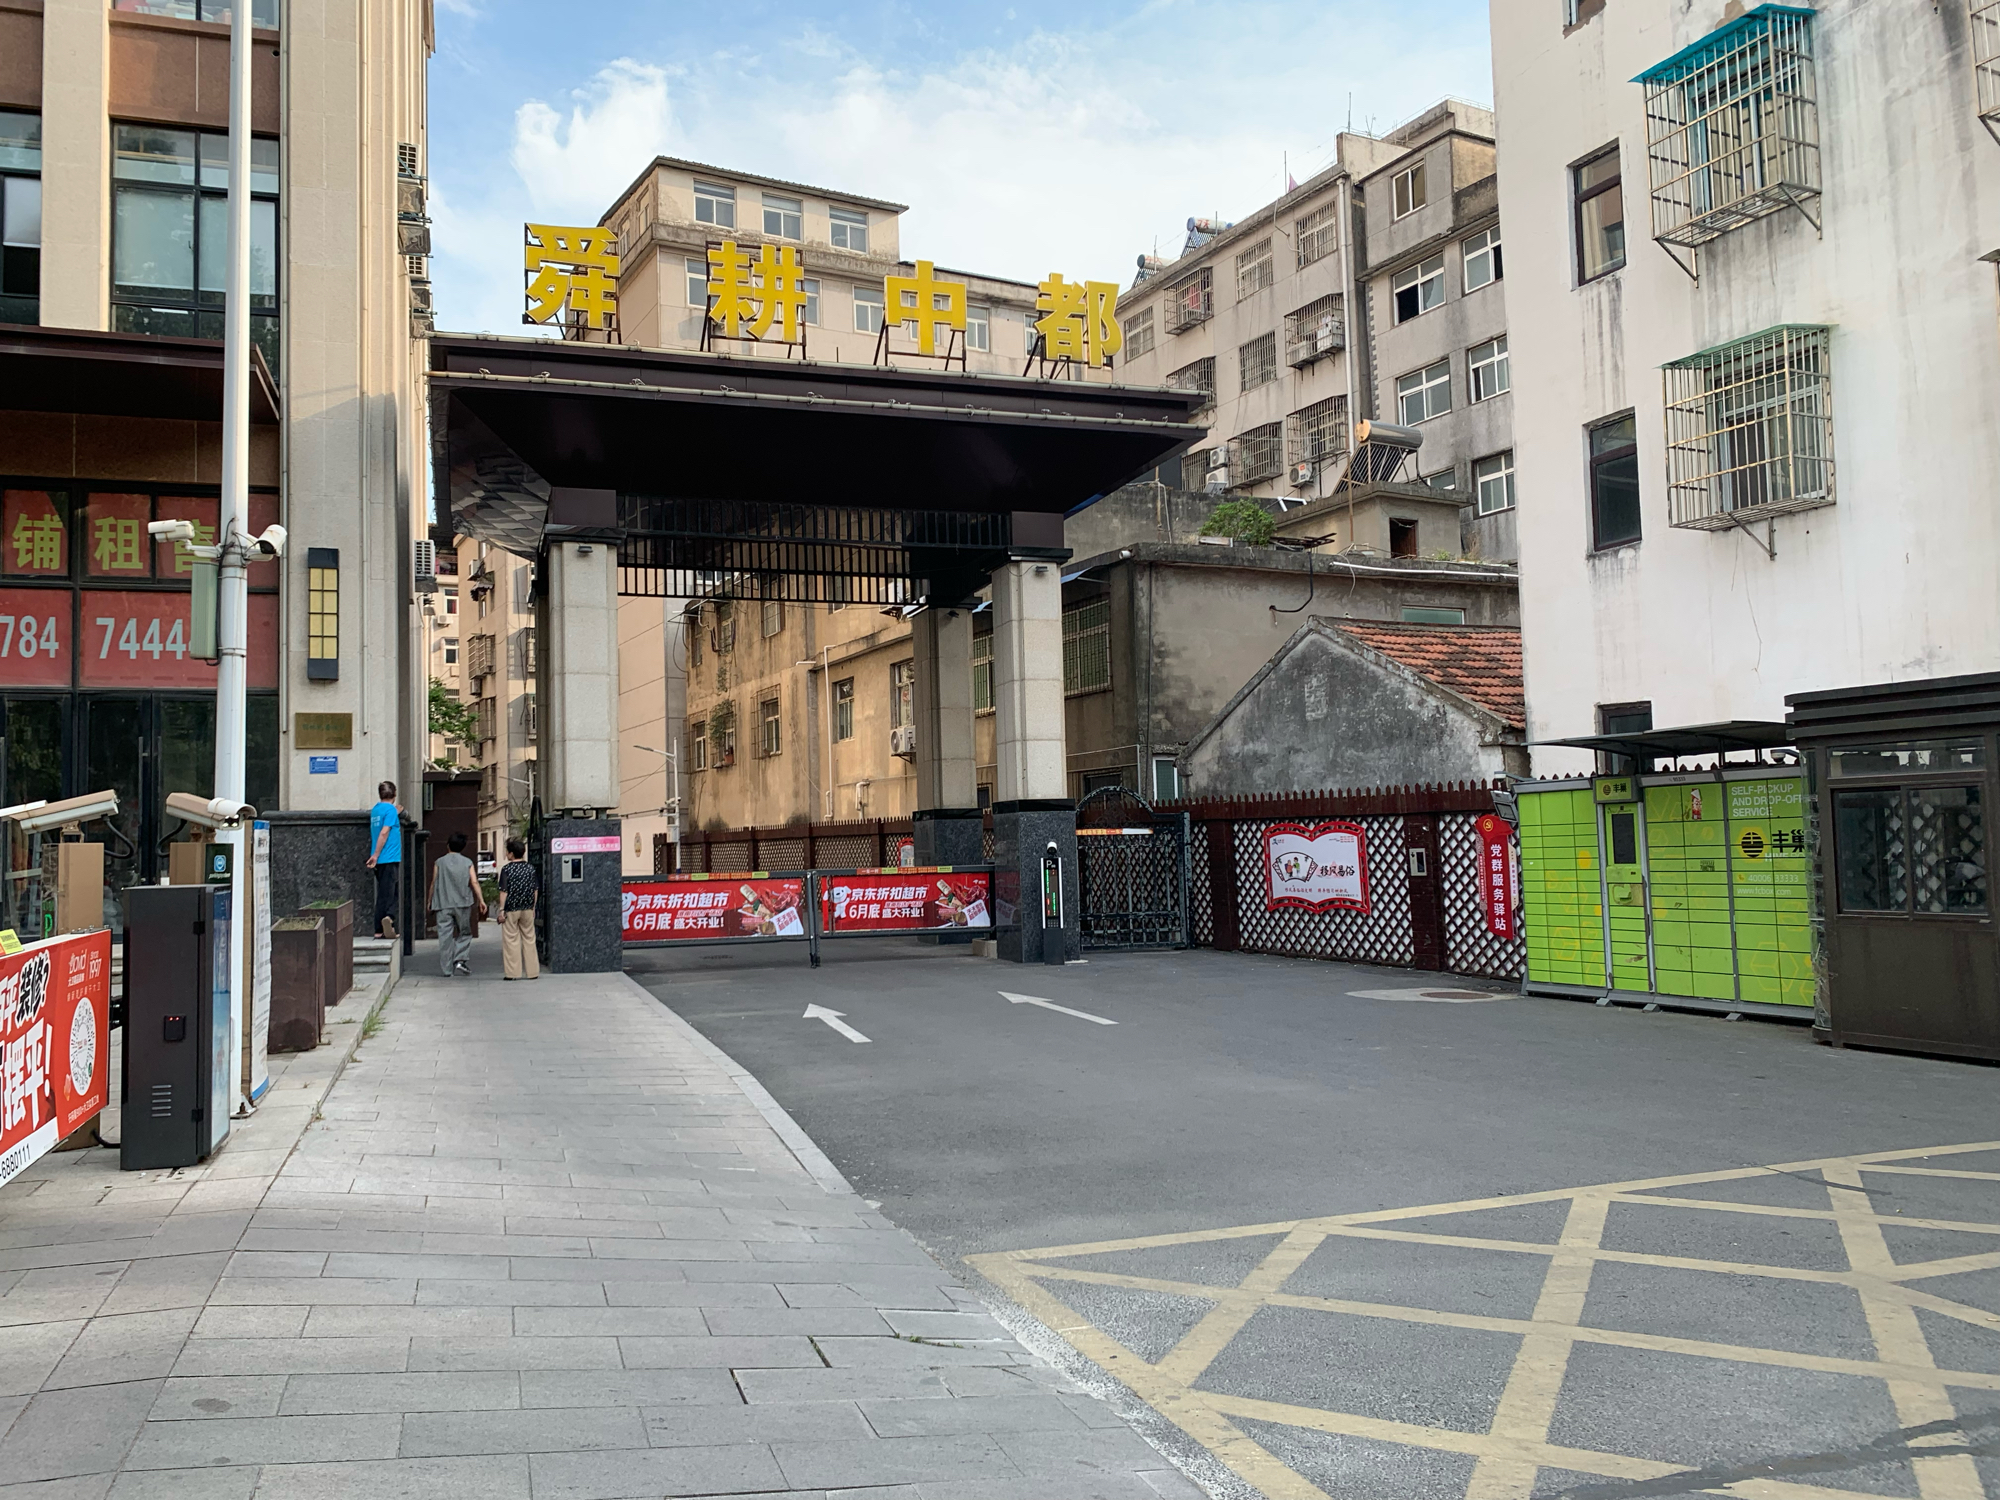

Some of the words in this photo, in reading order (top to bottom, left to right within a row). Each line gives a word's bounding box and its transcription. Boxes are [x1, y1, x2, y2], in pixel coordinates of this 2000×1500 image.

[526, 223, 1122, 369] 舜耕中都
[96, 617, 192, 660] 7444
[1731, 783, 1794, 796] SELF-PICKUP
[1732, 796, 1752, 806] AND
[1732, 806, 1773, 817] SERVICE
[1320, 865, 1355, 877] 移风易俗
[851, 886, 928, 901] 京东折扣超市
[1490, 844, 1506, 931] 党群服务驿站
[637, 892, 729, 909] 京东折扣超市
[849, 903, 880, 919] 6月底
[882, 907, 924, 919] 盛大开业!
[633, 912, 671, 931] 6月底
[674, 916, 724, 930] 盛大开业!
[89, 958, 102, 980] 1997
